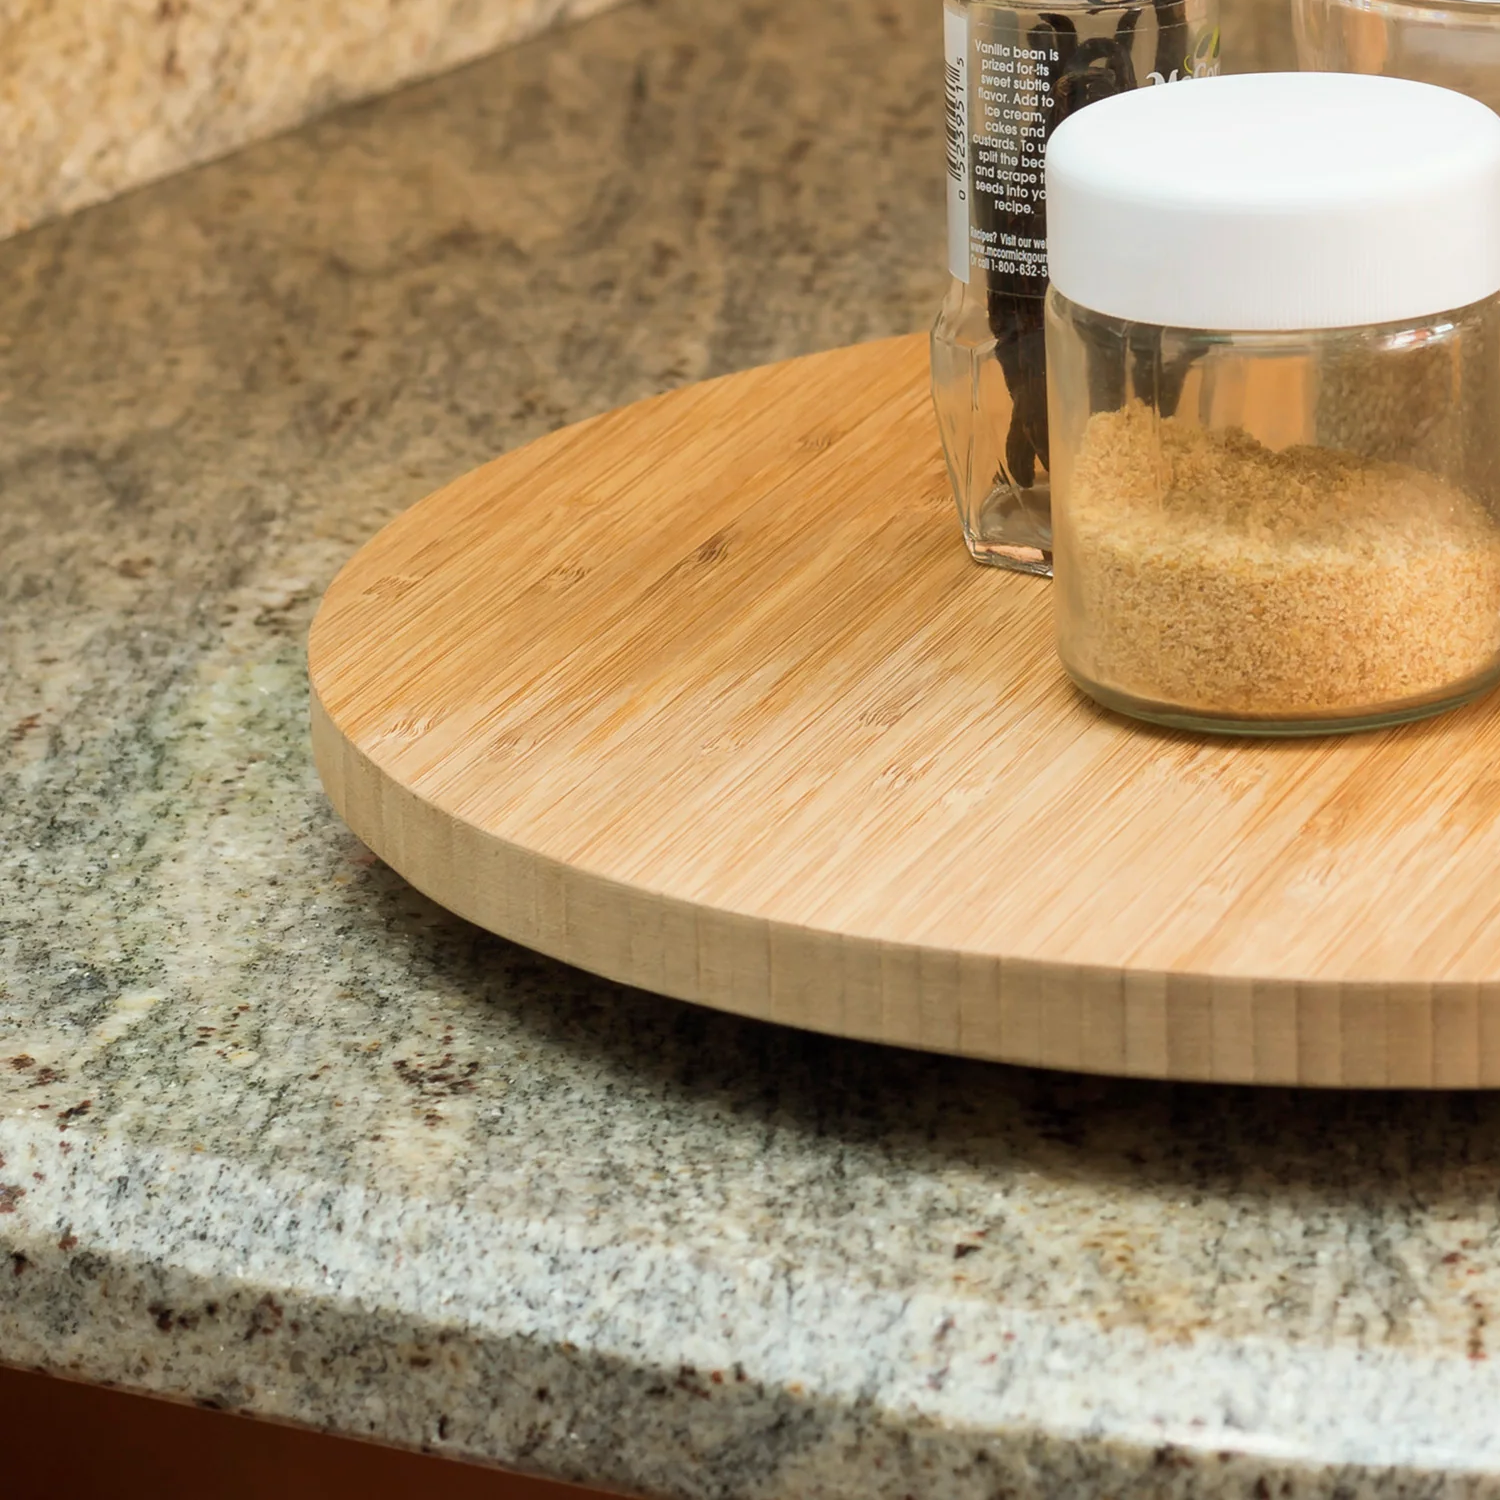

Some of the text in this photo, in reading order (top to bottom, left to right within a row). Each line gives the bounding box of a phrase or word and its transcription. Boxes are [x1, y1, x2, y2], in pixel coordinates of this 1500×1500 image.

[975, 39, 1059, 61] Vanilla bean is
[981, 58, 1050, 76] prized for its
[981, 74, 1050, 92] sweet subtle
[978, 86, 1055, 108] flavor. Add to
[984, 103, 1046, 124] ice cream,
[985, 121, 1045, 138] cakes and
[972, 134, 1018, 151] custards.
[1020, 140, 1035, 152] To
[978, 150, 1046, 168] split the bea
[975, 165, 994, 178] and
[997, 169, 1037, 185] scrape
[975, 180, 1047, 202] seeds into yo
[994, 200, 1035, 215] recipe.
[1000, 233, 1017, 246] Visit
[1018, 237, 1032, 248] our
[970, 241, 1048, 264] www.mccormickgour
[978, 257, 990, 269] call
[991, 258, 1048, 277] 1-800-632-5
